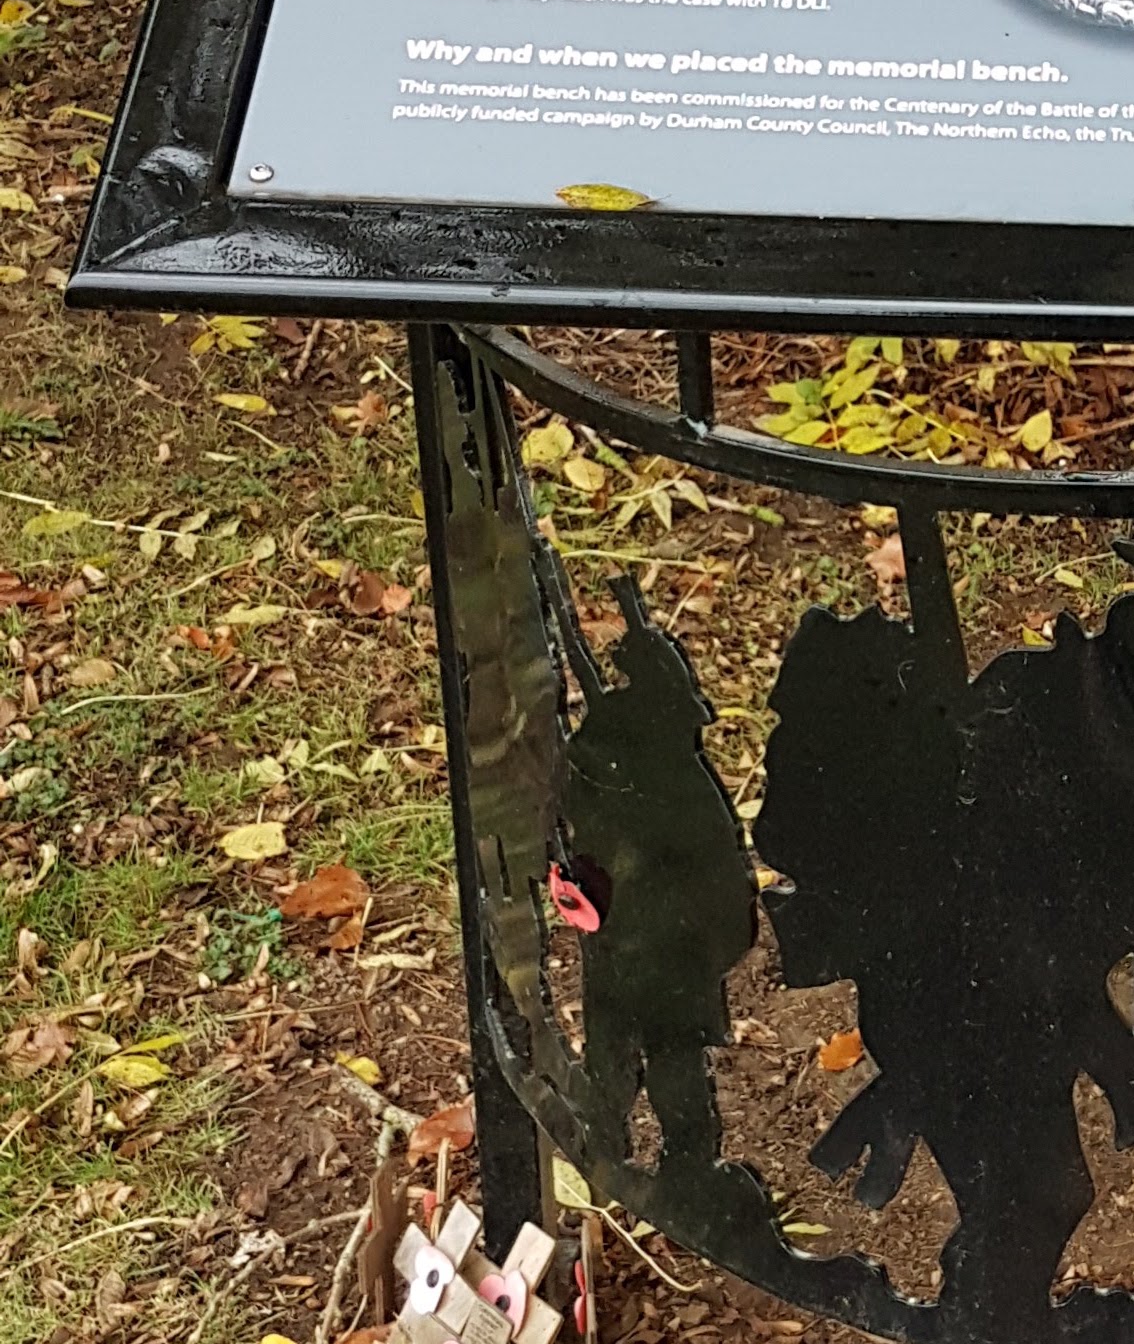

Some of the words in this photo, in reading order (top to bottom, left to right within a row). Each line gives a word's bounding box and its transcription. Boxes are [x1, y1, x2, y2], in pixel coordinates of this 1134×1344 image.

[407, 39, 471, 65] Why
[475, 43, 533, 64] and
[538, 45, 617, 67] when
[624, 53, 666, 69] we
[671, 50, 768, 74] placed
[773, 53, 822, 75] the
[828, 59, 965, 79] memorial
[972, 60, 1068, 82] bench.
[399, 79, 435, 94] This
[439, 83, 529, 98] memorial
[532, 84, 591, 100] bench
[594, 86, 626, 102] has
[630, 89, 678, 104] been
[682, 93, 816, 109] commissioned
[820, 95, 845, 110] for
[849, 96, 880, 111] the
[884, 97, 979, 117] Centenary
[982, 100, 1004, 115] of
[1006, 101, 1037, 116] the
[1041, 102, 1094, 118] Battle
[1098, 103, 1119, 118] of
